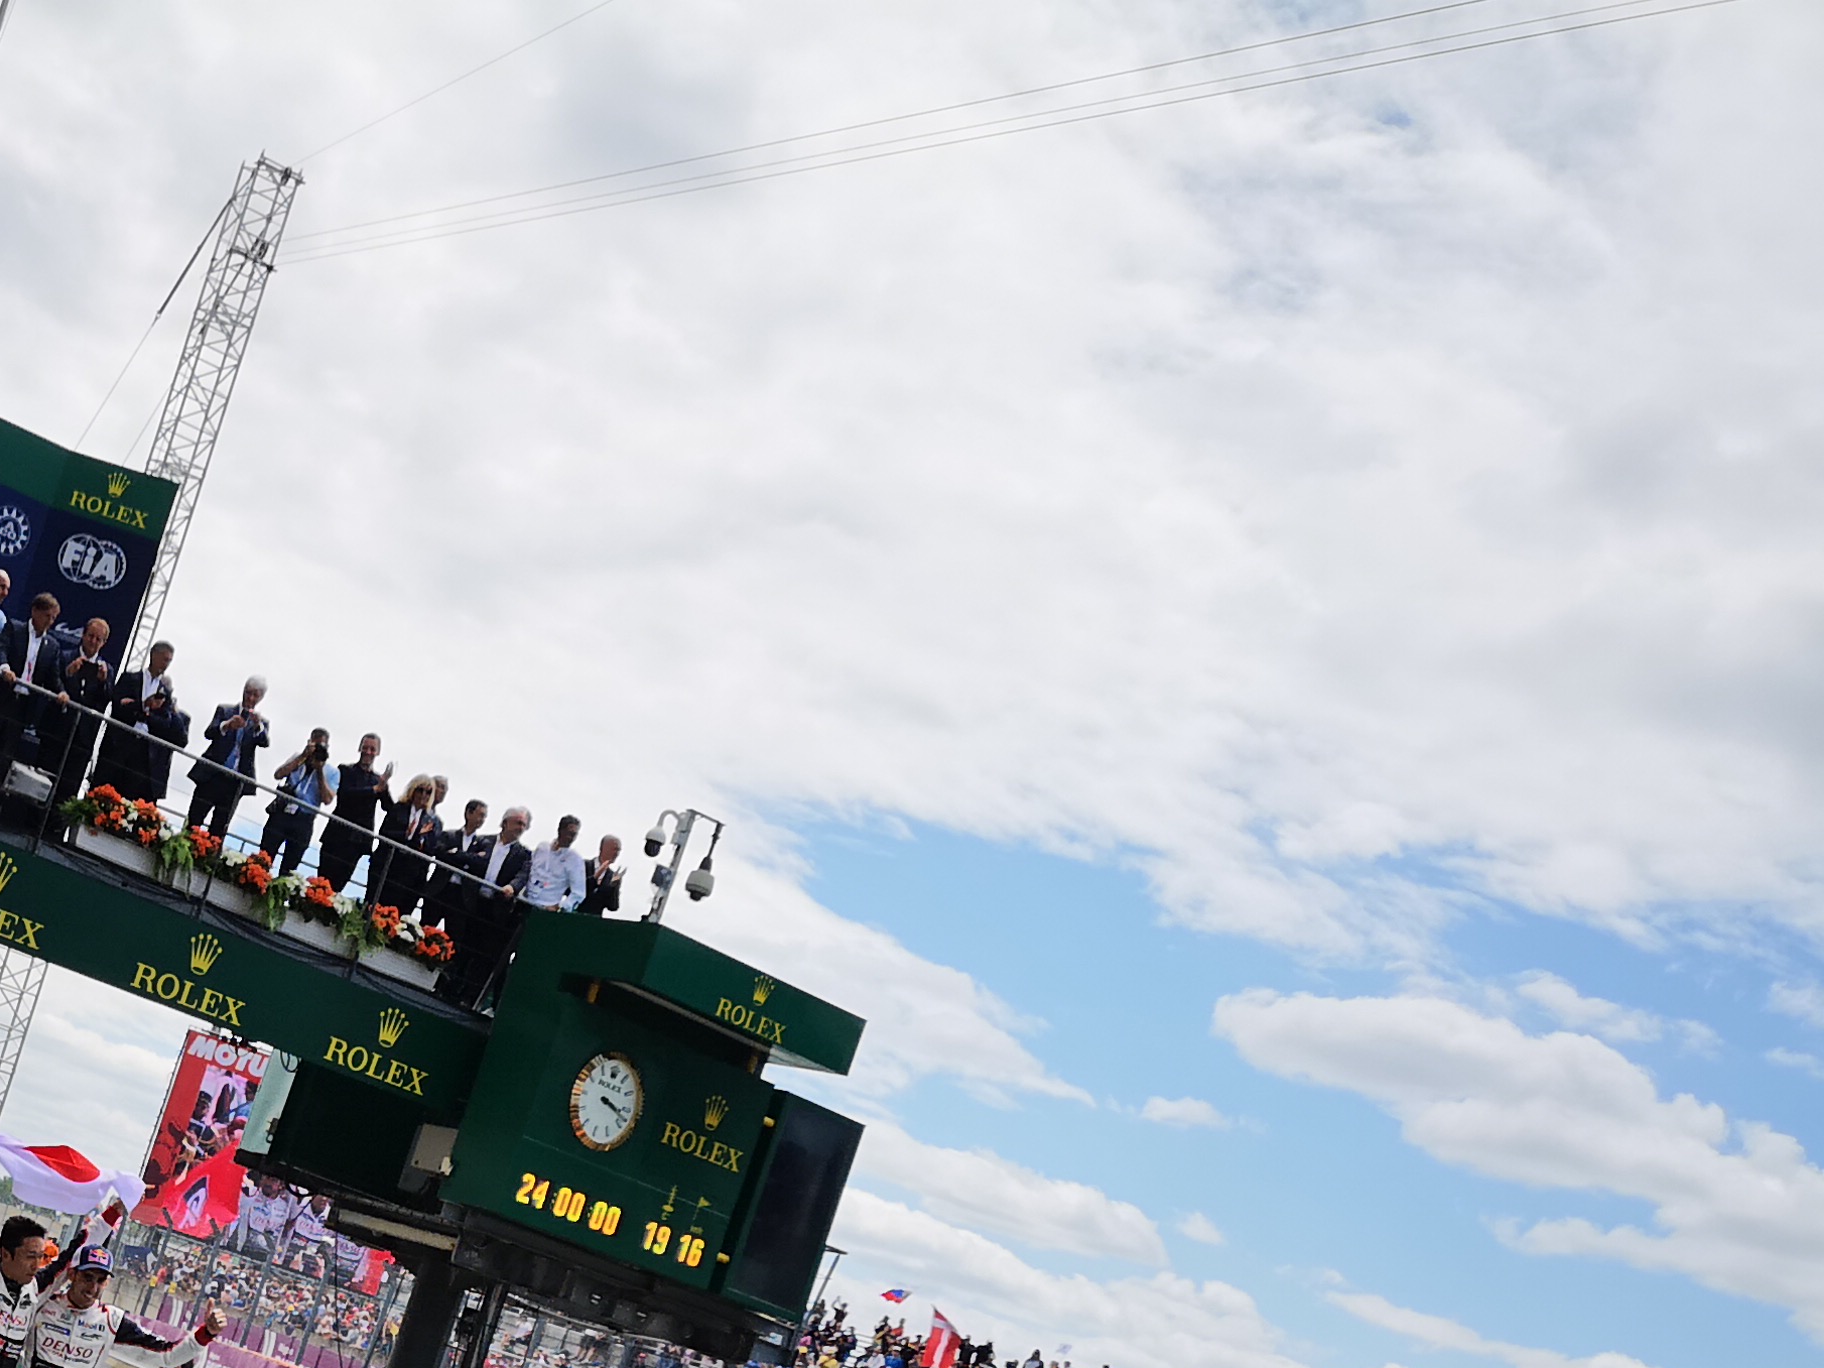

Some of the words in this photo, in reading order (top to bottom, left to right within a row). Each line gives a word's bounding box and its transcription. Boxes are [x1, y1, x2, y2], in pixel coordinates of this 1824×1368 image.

[69, 490, 150, 529] ROLEX
[130, 962, 247, 1027] ROLEX
[715, 997, 787, 1045] ROLEX
[188, 1034, 271, 1079] MOTU
[324, 1036, 429, 1096] ROLEX
[598, 1079, 623, 1094] ROLEX
[661, 1122, 744, 1173] ROLEX
[642, 1222, 671, 1255] 19
[678, 1234, 705, 1267] 16
[42, 1337, 93, 1358] DENSO
